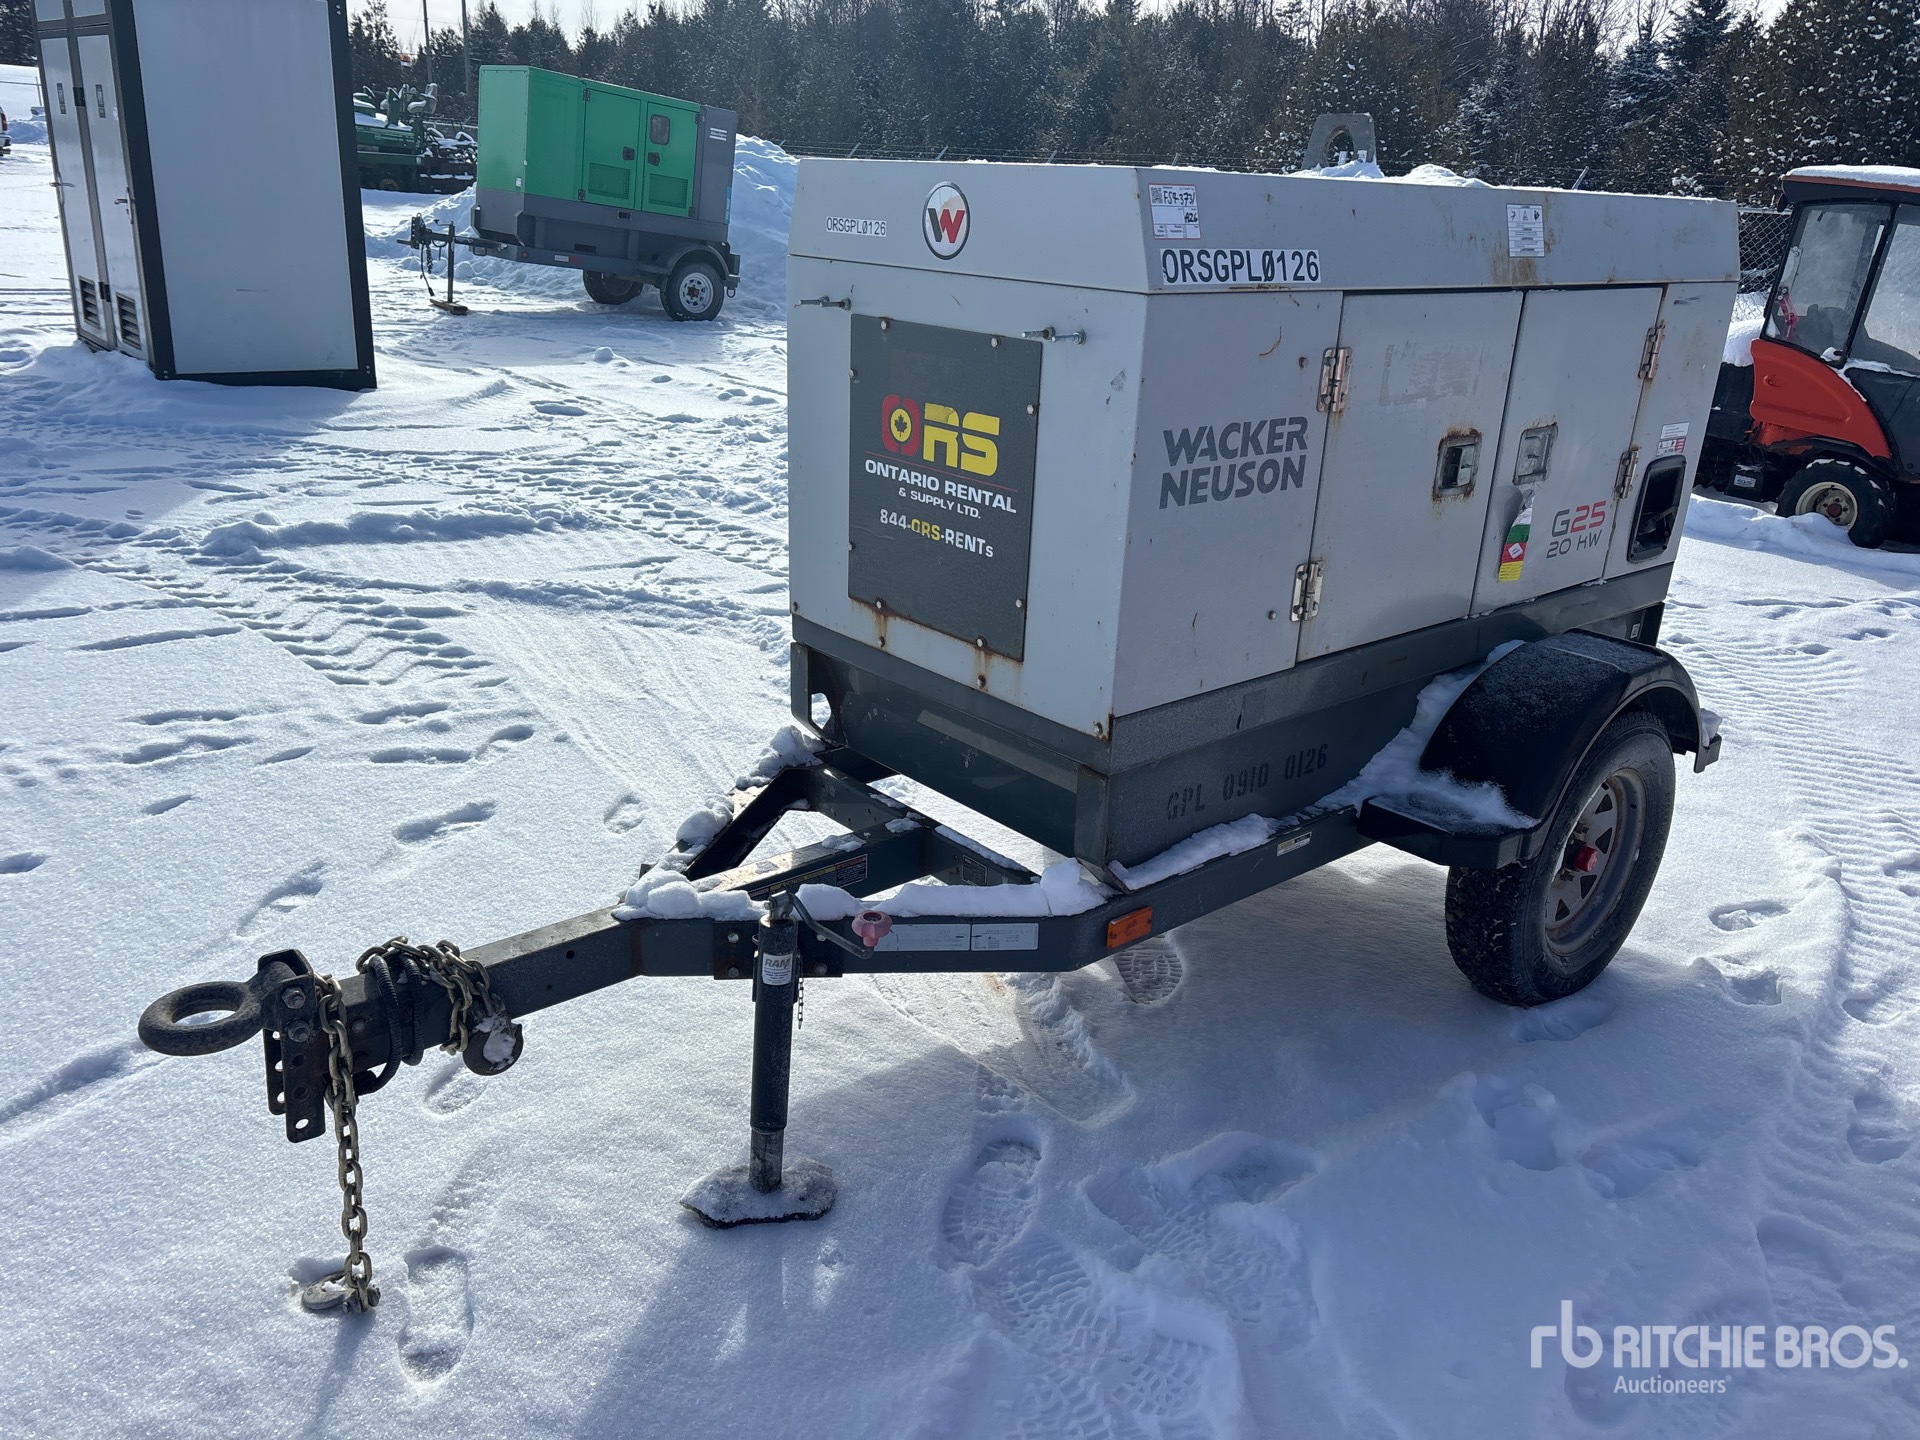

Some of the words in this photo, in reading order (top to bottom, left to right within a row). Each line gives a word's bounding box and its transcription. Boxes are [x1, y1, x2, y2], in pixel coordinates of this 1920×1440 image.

[1163, 416, 1308, 467] WACKER
[865, 459, 940, 492] ONTARIO
[944, 480, 1017, 514] RENTAL
[898, 487, 907, 498] &
[910, 490, 955, 511] SUPPLY
[957, 503, 981, 519] LTD.
[1159, 454, 1306, 509] NEUSON
[1552, 500, 1606, 537] G25
[1546, 538, 1571, 559] 20
[1167, 784, 1205, 820] GPL
[1285, 743, 1328, 781] 0126
